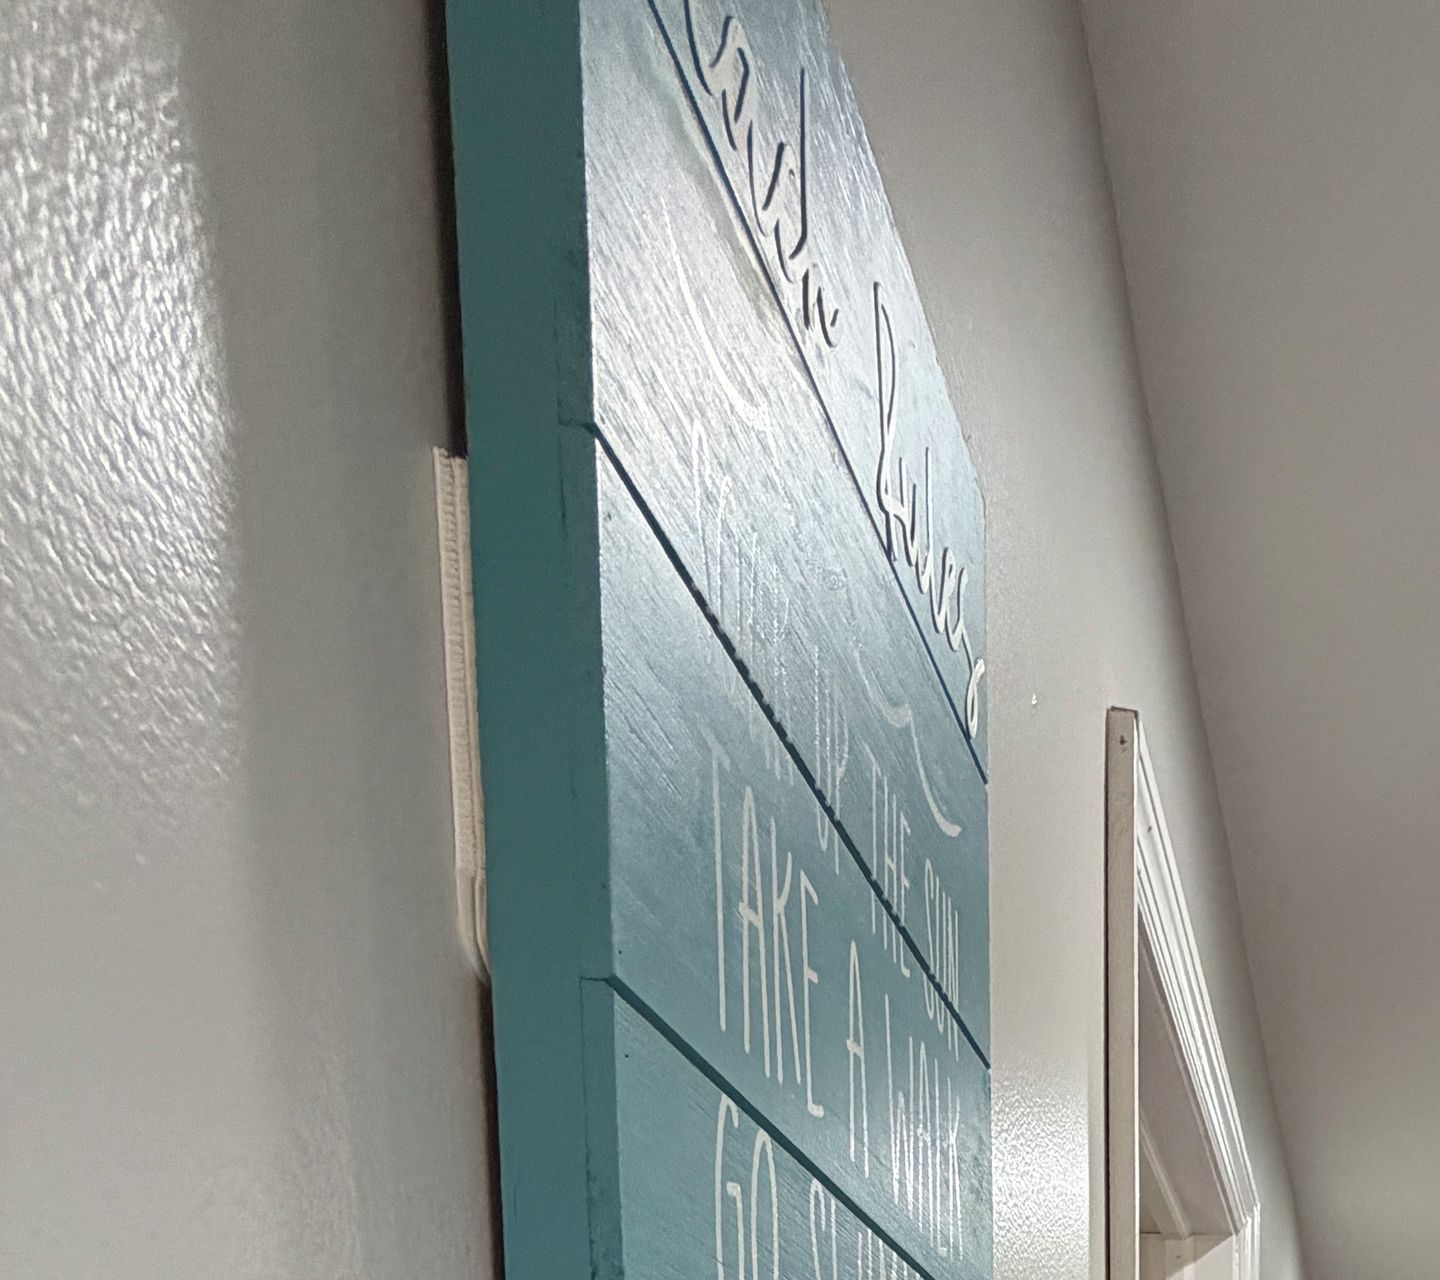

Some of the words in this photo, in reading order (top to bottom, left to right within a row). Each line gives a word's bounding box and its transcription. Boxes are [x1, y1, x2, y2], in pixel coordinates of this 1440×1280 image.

[691, 418, 795, 786] SOAK
[813, 643, 849, 876] UP
[862, 741, 911, 977] THE
[924, 857, 959, 1062] SUN
[873, 281, 986, 740] Rules
[704, 727, 824, 1118] TAKE
[846, 940, 870, 1179] A
[885, 993, 963, 1263] WALK
